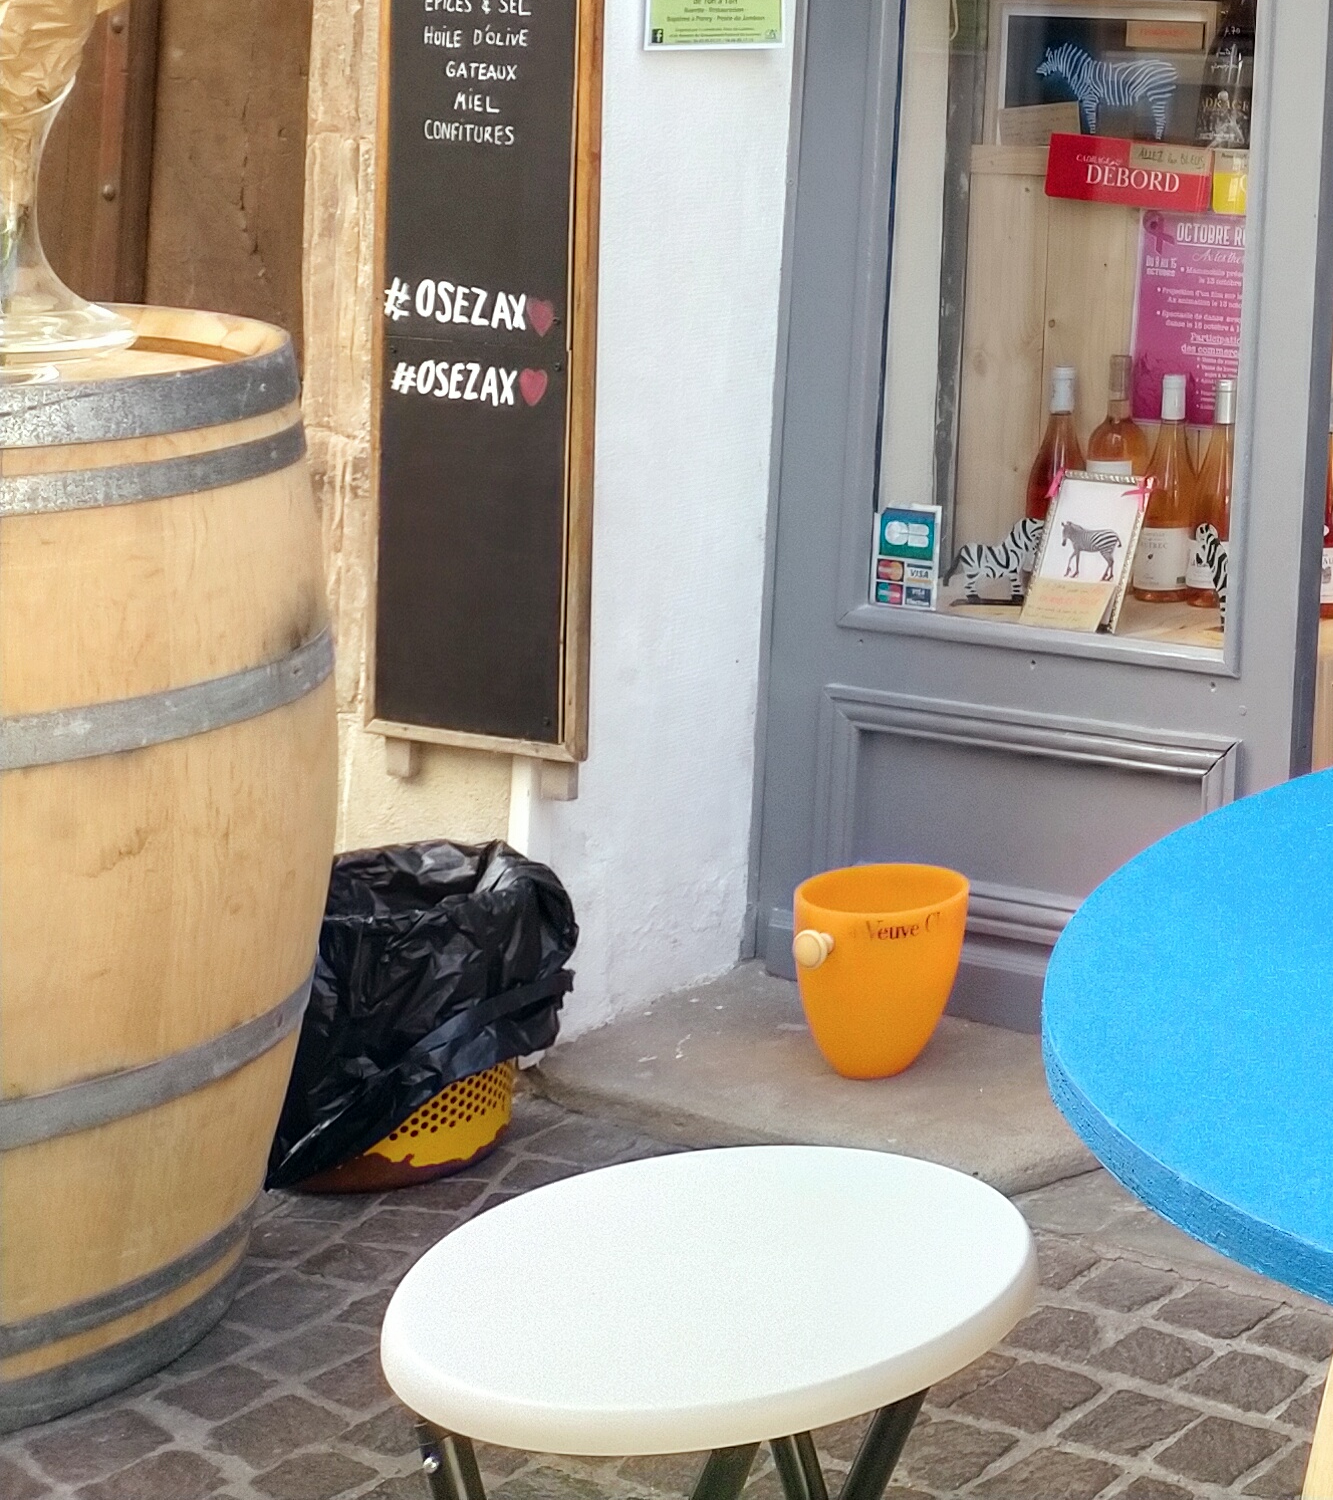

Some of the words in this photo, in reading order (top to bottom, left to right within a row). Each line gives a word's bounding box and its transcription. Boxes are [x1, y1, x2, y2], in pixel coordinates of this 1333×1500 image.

[424, 24, 461, 48] HUILE
[445, 61, 517, 81] GATEAUX
[454, 89, 499, 114] MIEL
[424, 118, 514, 145] CONFITURES
[1177, 222, 1230, 246] OCTOBRE
[384, 277, 526, 330] #OSEZAX
[391, 360, 517, 407] #OSEZAX
[910, 570, 928, 579] VISA
[865, 919, 920, 941] Veuve
